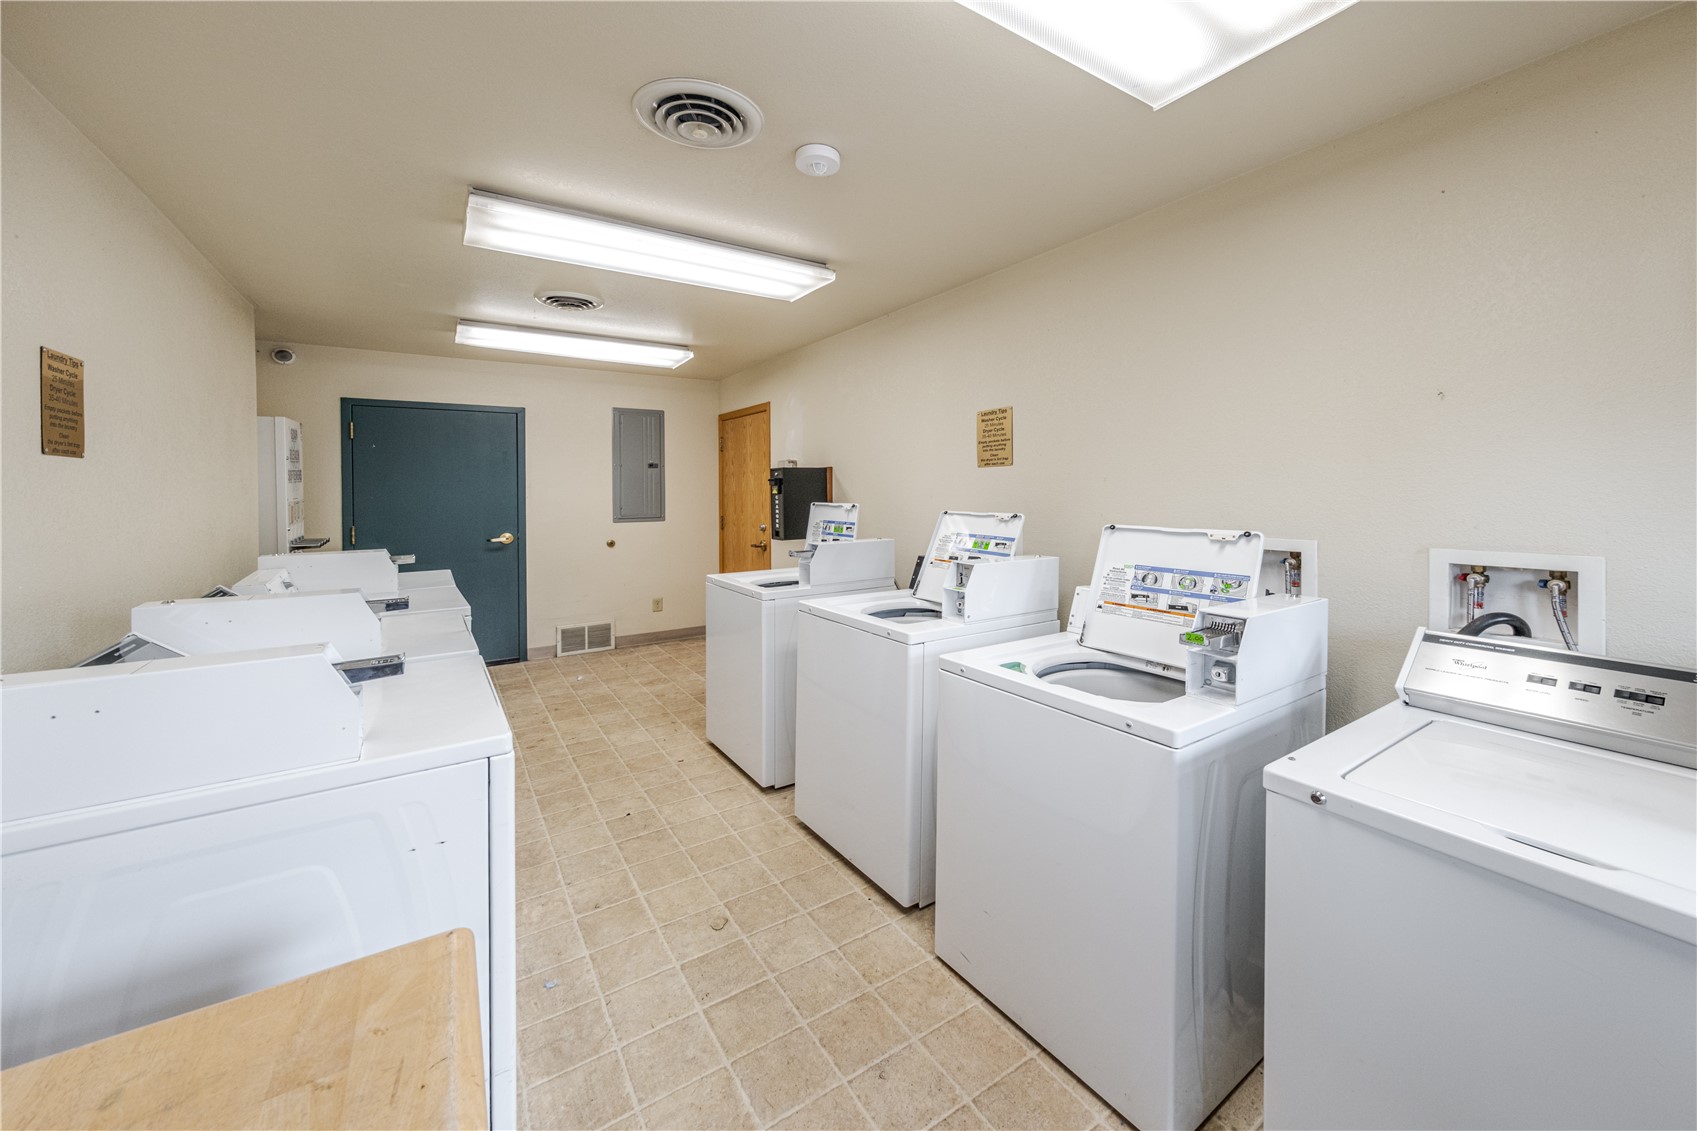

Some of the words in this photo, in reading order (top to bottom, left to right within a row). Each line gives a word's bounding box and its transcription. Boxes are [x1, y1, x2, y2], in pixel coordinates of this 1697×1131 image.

[47, 350, 67, 366] Laundry
[69, 358, 79, 369] Tips
[48, 364, 65, 375] Washer
[66, 370, 78, 379] Cycle
[50, 384, 62, 394] Dryer
[64, 388, 76, 398] Cycle
[1187, 634, 1204, 643] 2.00
[1452, 660, 1487, 670] Whirlpool
[1620, 706, 1654, 714] TEMPERATURE
